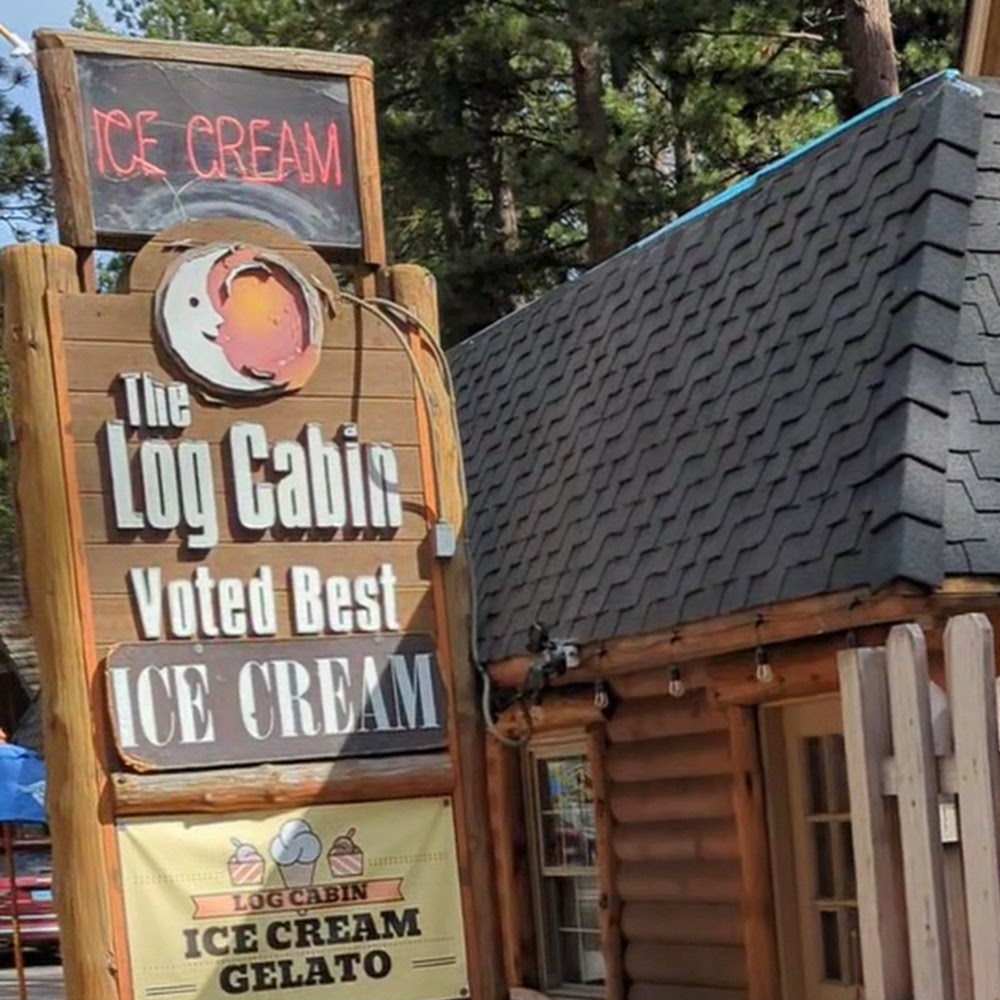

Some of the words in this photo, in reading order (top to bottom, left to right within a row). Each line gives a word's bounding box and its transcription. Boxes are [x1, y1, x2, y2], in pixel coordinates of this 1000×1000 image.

[92, 107, 166, 180] ICE
[186, 115, 344, 188] CREAM
[119, 372, 192, 427] The
[106, 420, 219, 549] Log
[229, 421, 402, 530] Cabin
[130, 565, 277, 640] Voted
[291, 563, 399, 635] Best
[109, 663, 215, 748] ICE
[238, 653, 440, 741] CREAM
[232, 892, 283, 912] LOG
[289, 884, 368, 906] CABIN
[183, 924, 258, 959] ICE
[266, 908, 421, 951] CREAM
[219, 950, 392, 995] GELATO
